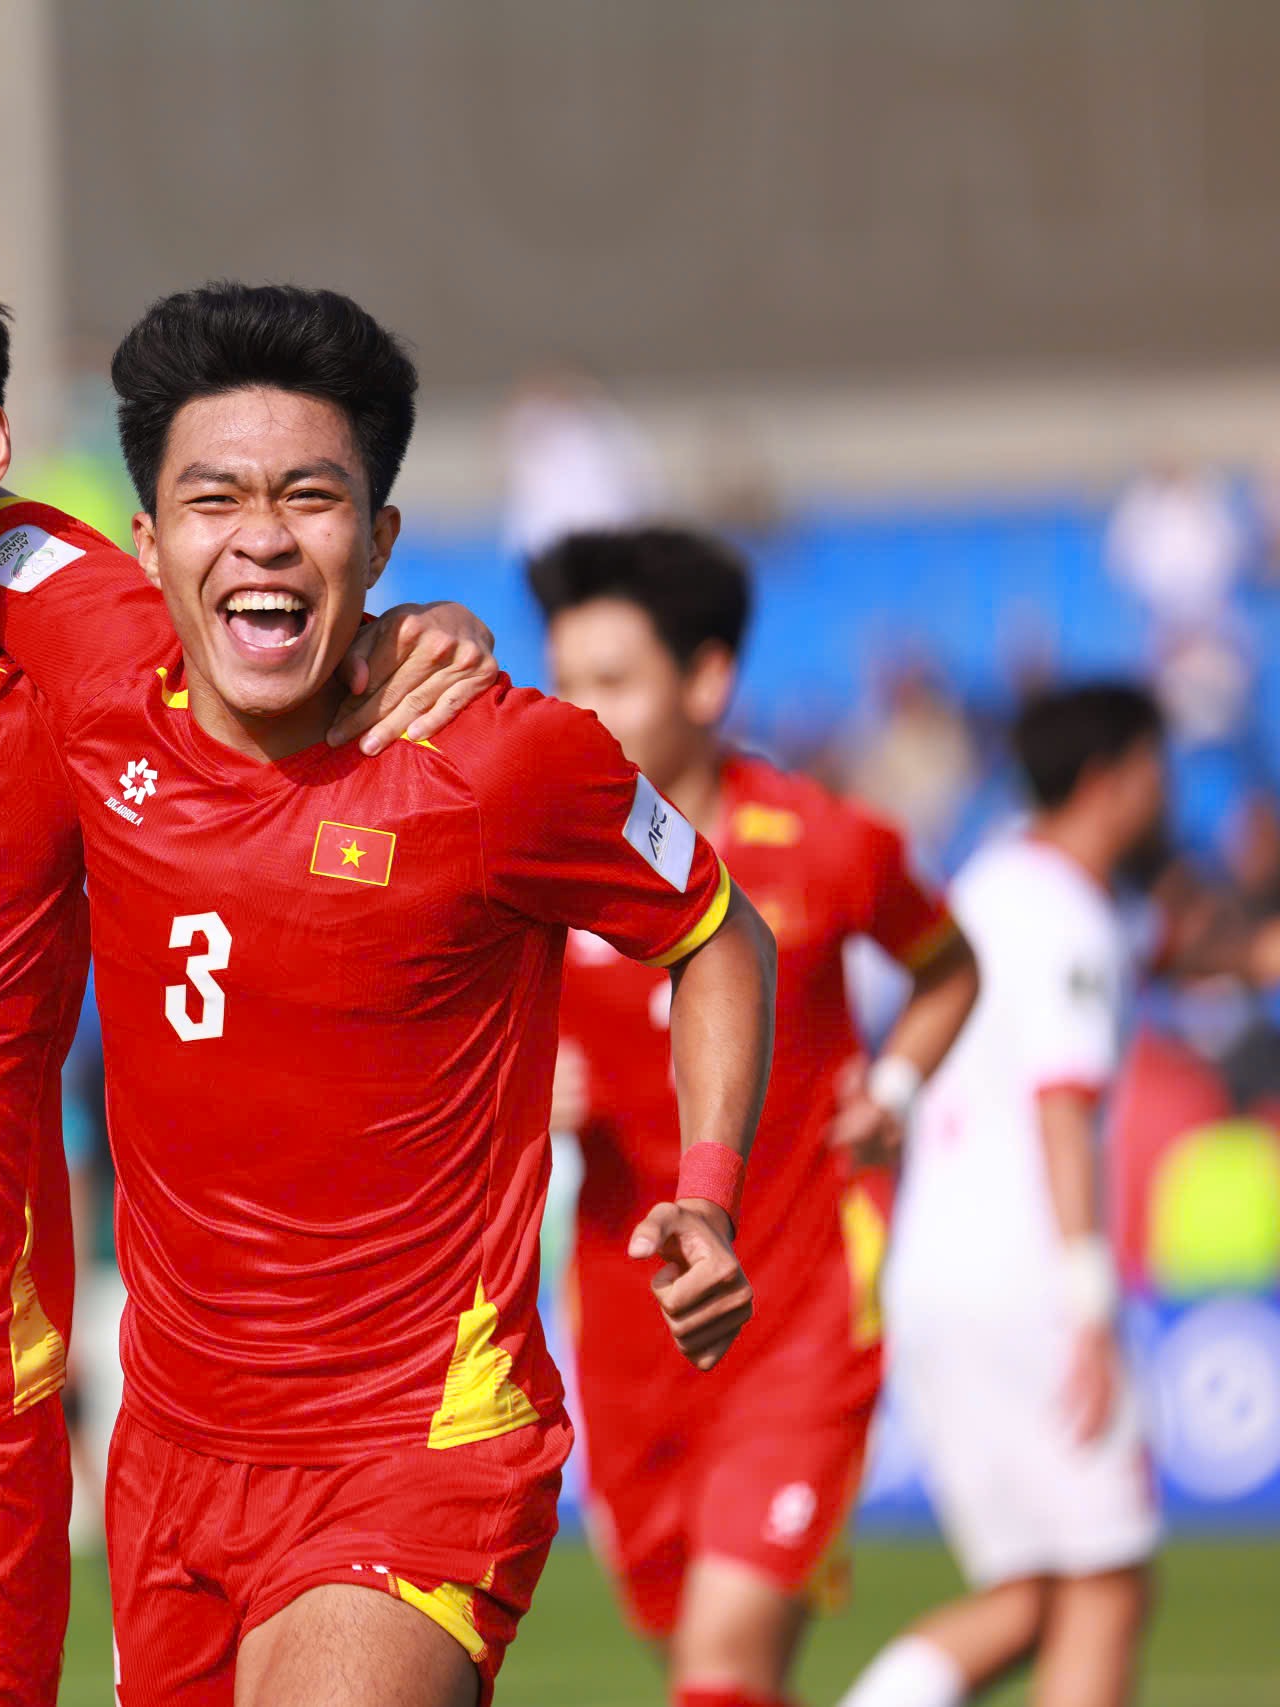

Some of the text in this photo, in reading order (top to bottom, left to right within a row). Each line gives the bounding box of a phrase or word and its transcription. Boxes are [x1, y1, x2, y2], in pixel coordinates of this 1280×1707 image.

[4, 531, 27, 553] ASIAN
[13, 539, 29, 553] AFC
[648, 802, 667, 861] AFC
[164, 911, 233, 1042] 3
